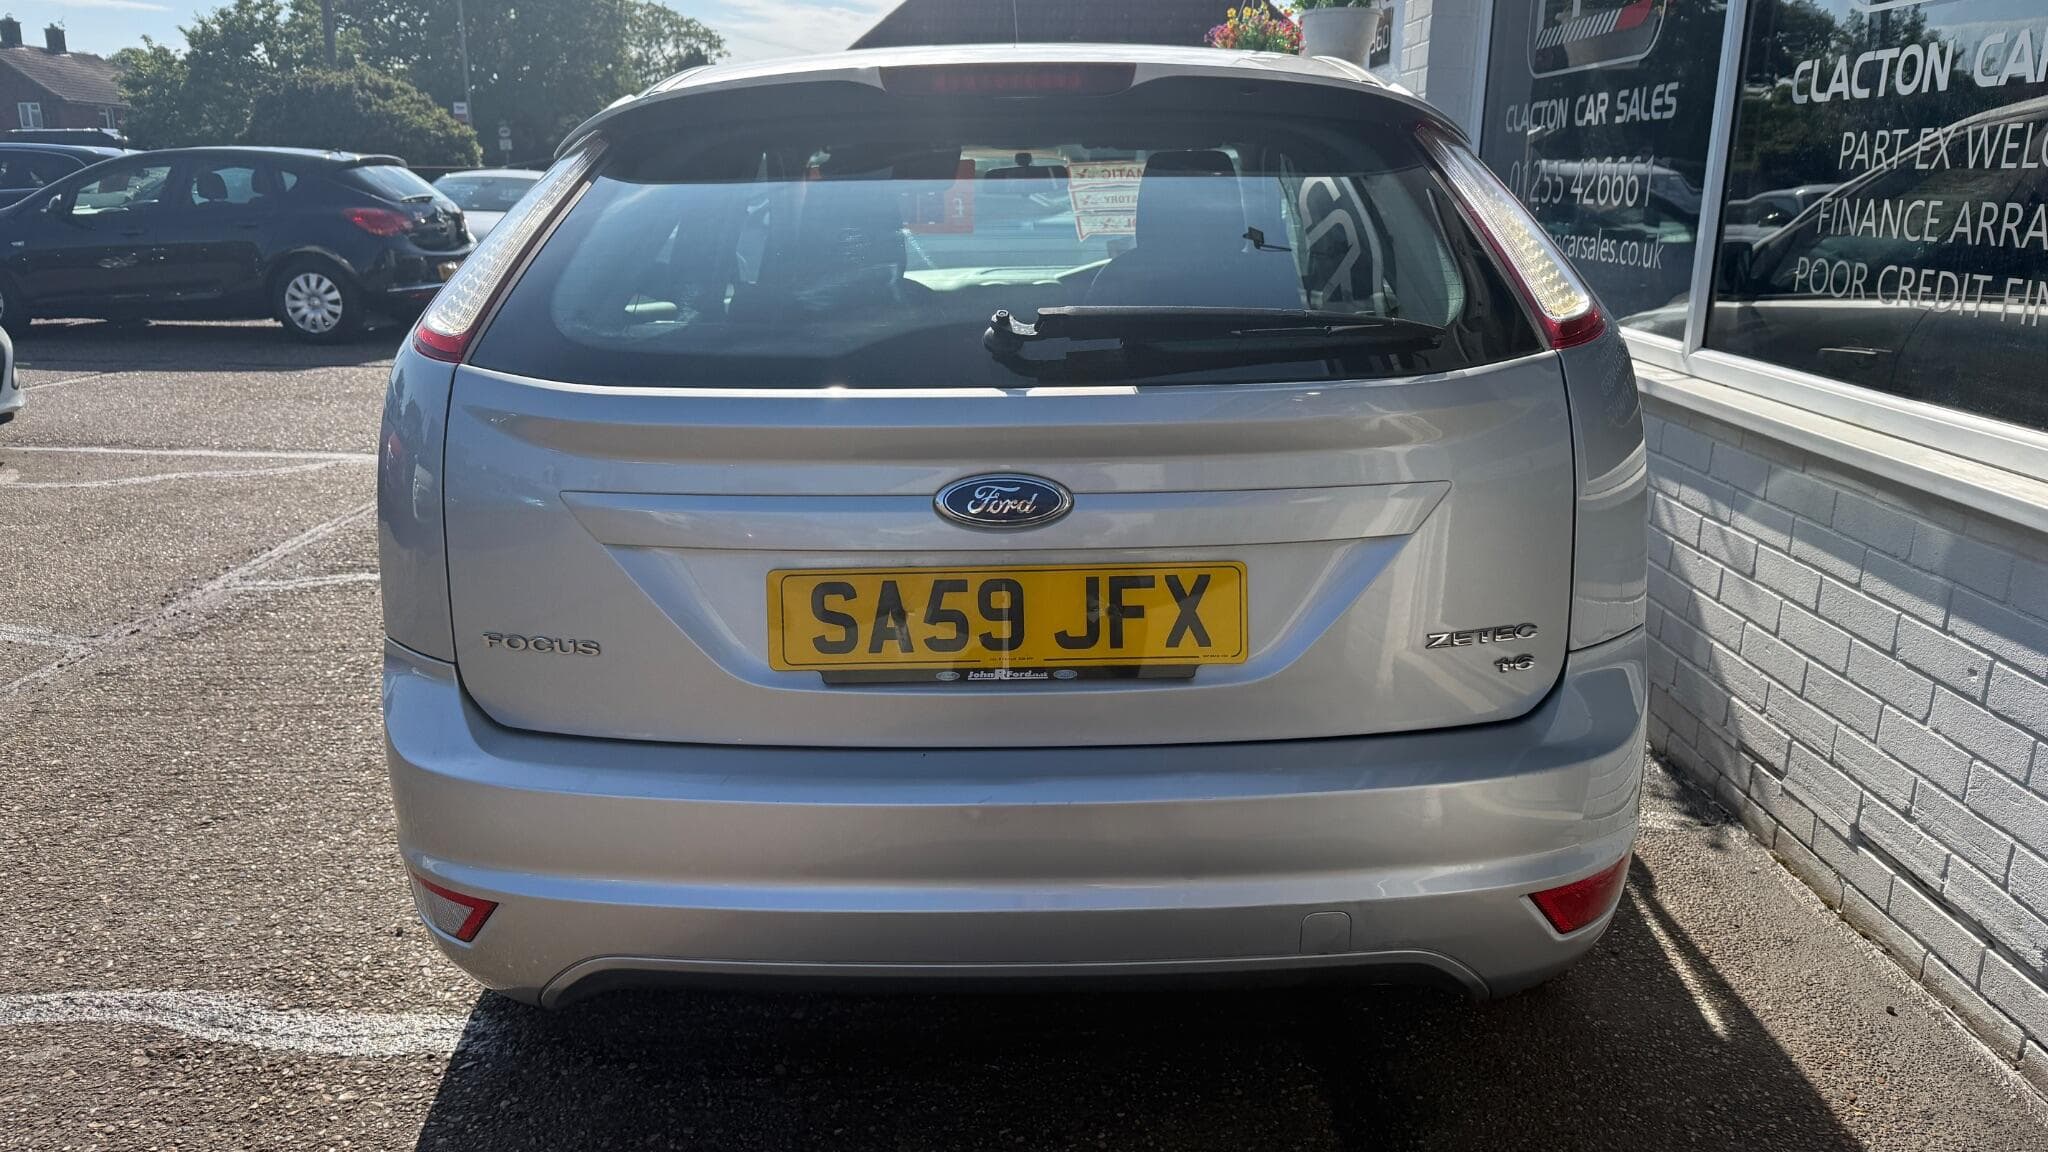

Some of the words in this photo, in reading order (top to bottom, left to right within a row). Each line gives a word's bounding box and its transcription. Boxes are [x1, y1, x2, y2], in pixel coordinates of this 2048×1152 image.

[1791, 38, 1956, 104] CLACTON
[1505, 98, 1569, 133] CLACTON
[1574, 92, 1609, 127] CAR
[1615, 81, 1679, 124] SALES
[1838, 128, 1909, 170] PART
[1914, 126, 1957, 170] EX
[1509, 158, 1564, 204] 01255
[1570, 155, 1655, 207] 426661
[1817, 197, 1943, 243] FINANCE
[1549, 228, 1665, 269] ncarsales.co.uk
[1793, 256, 1869, 300] POOR
[1877, 264, 1993, 319] CREDIT
[967, 485, 1039, 515] Ford
[809, 577, 1026, 655] SA59
[1054, 573, 1212, 651] JFX
[1425, 622, 1538, 650] ZETEC
[481, 631, 601, 657] FOCUS
